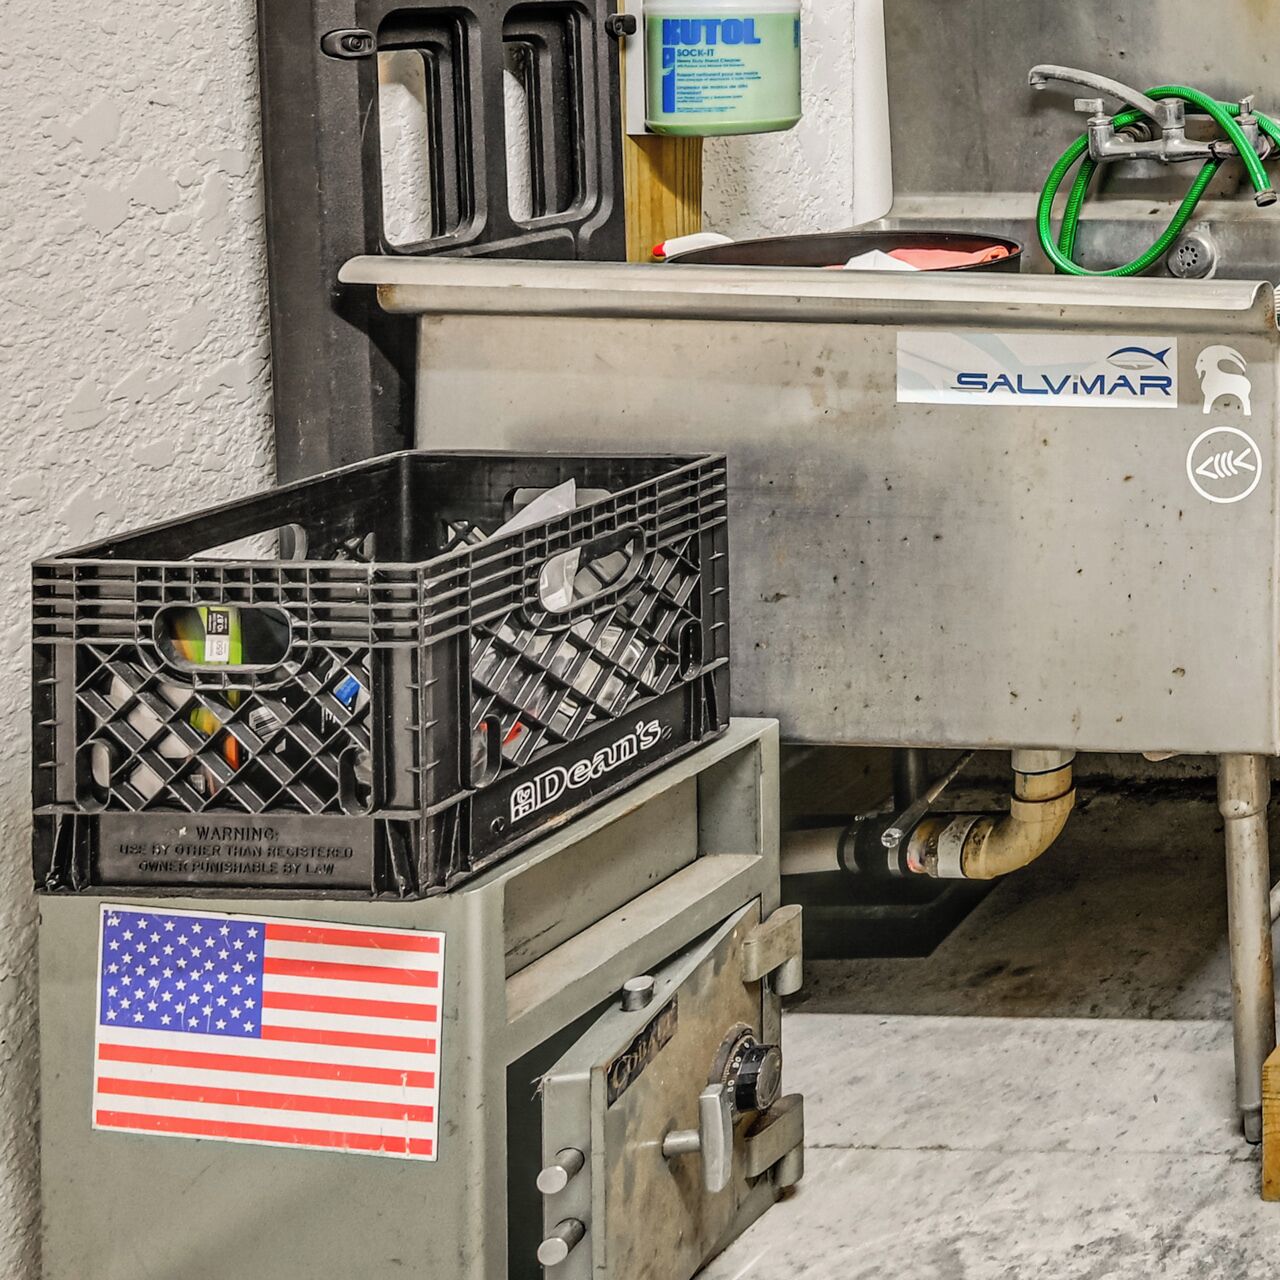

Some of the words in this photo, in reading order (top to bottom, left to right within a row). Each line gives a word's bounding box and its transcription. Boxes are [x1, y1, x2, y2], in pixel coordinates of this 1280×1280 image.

[662, 18, 761, 45] KUTOL
[677, 49, 714, 57] SOCK-IT
[534, 720, 662, 811] Dean's
[119, 844, 146, 855] USE
[152, 844, 170, 855] BY
[175, 844, 220, 856] OTHER
[227, 845, 262, 857] THAN
[267, 847, 354, 858] REGISTERED
[139, 861, 189, 872] OWNER
[190, 861, 277, 874] PUNISHABLE
[283, 863, 301, 874] BY
[306, 863, 335, 875] LAW
